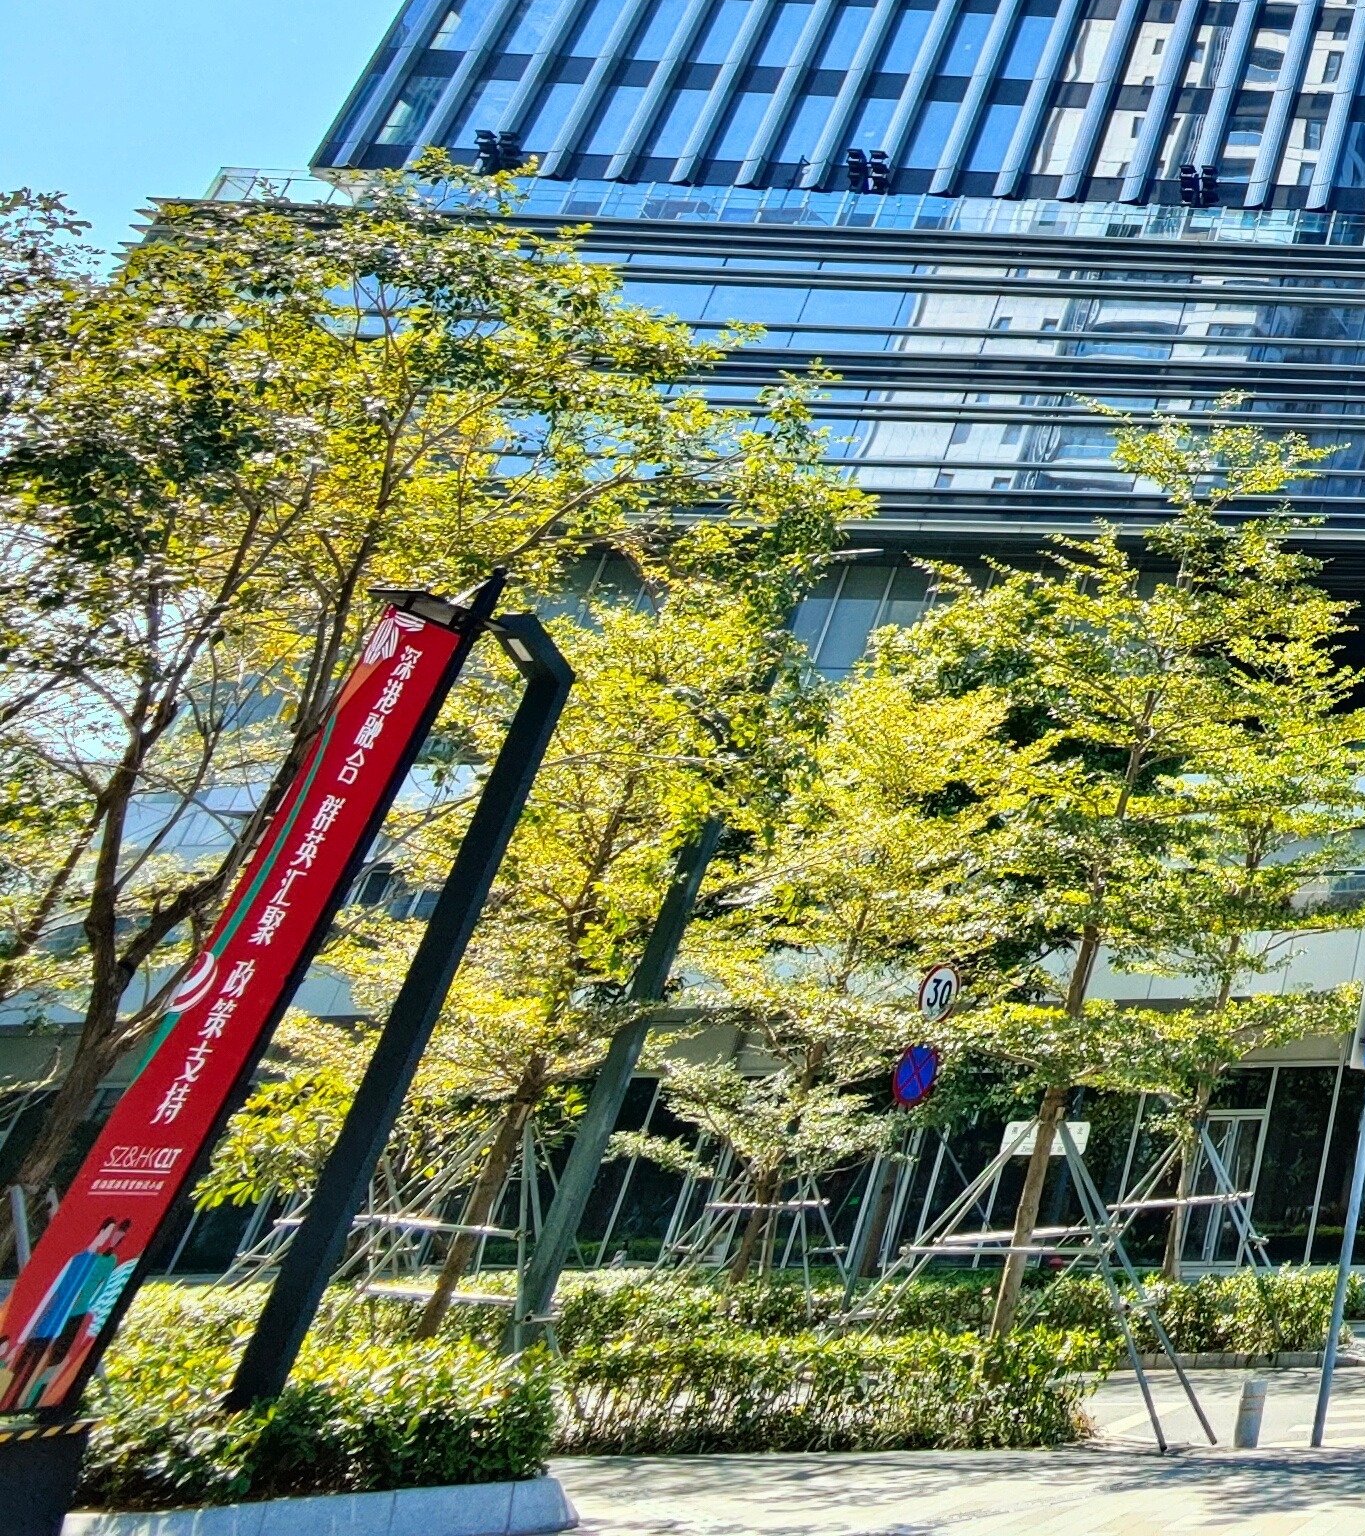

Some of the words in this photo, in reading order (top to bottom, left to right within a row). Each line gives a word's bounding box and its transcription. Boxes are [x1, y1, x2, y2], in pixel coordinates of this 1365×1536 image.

[337, 645, 423, 785] 深港融合
[248, 794, 346, 946] 群英汇聚
[150, 959, 255, 1125] 政策支持
[927, 978, 952, 1008] 30
